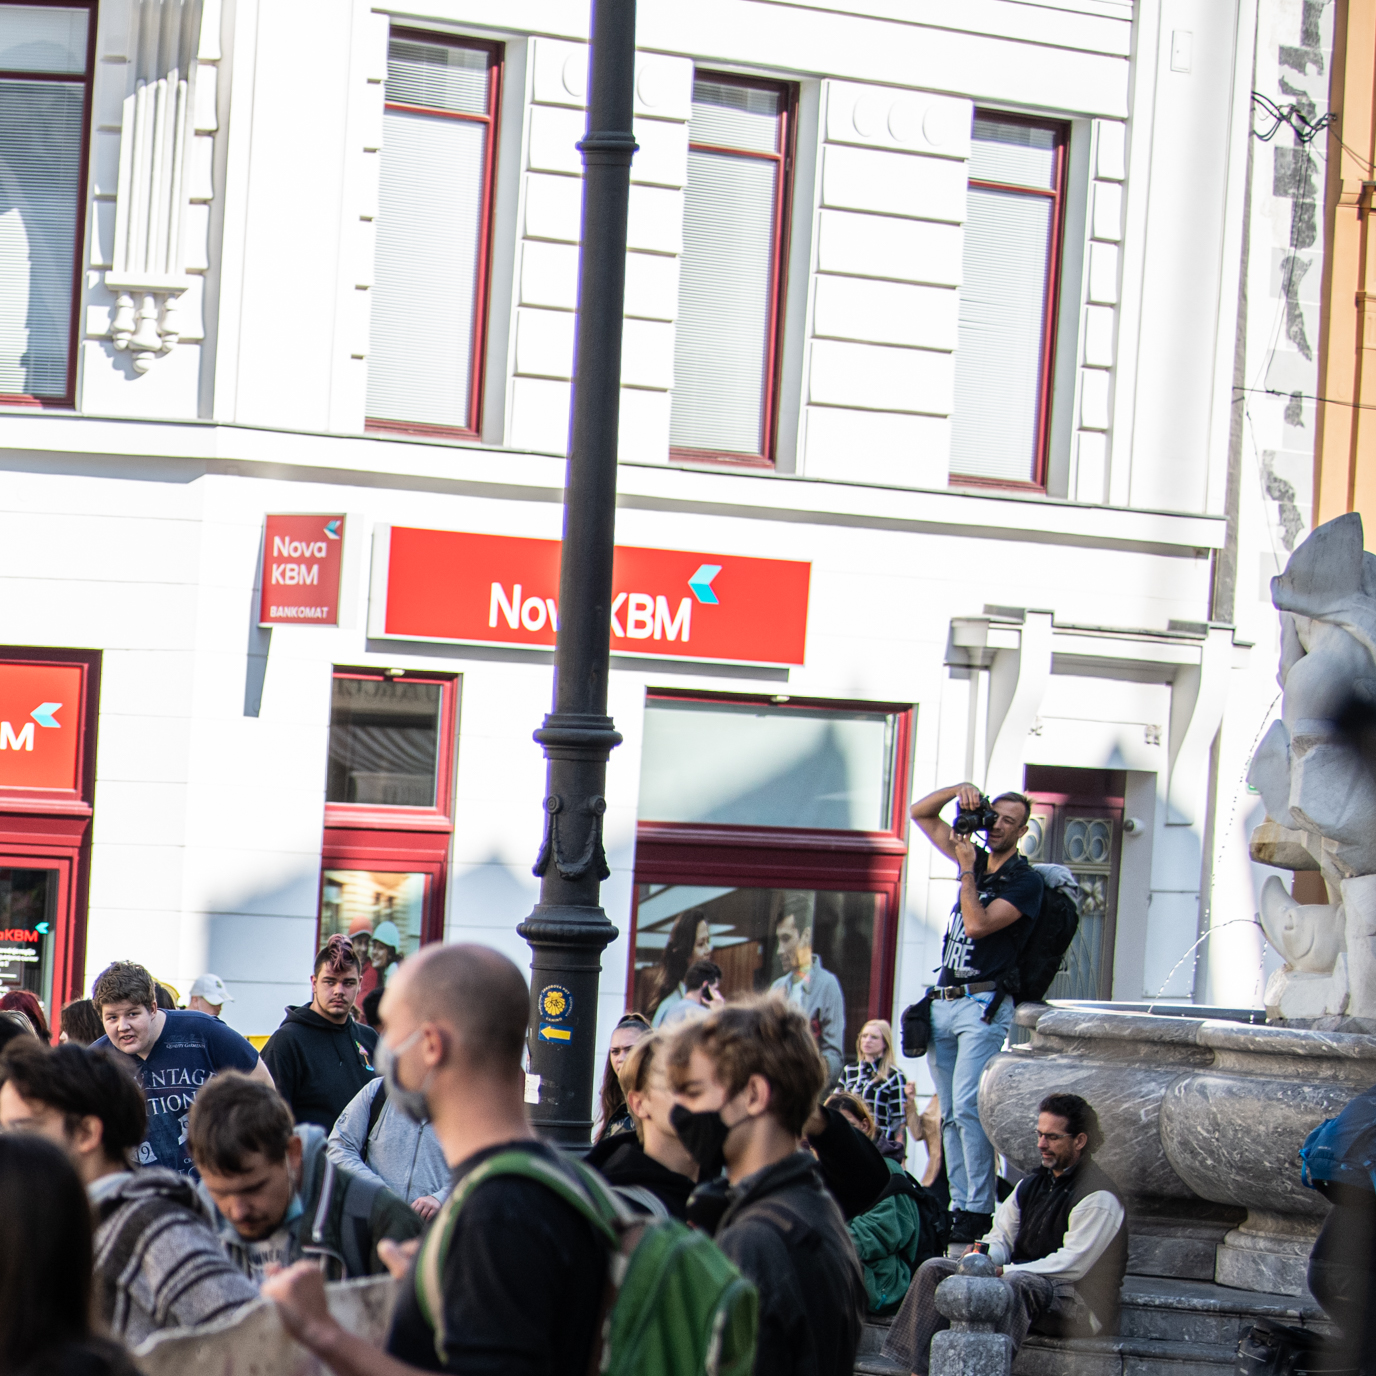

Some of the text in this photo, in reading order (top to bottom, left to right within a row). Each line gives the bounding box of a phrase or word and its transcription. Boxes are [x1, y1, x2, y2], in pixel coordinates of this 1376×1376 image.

[273, 535, 327, 558] Nova
[271, 563, 319, 585] KBM
[270, 606, 328, 618] BANKOMAT
[489, 582, 692, 642] NovKBM
